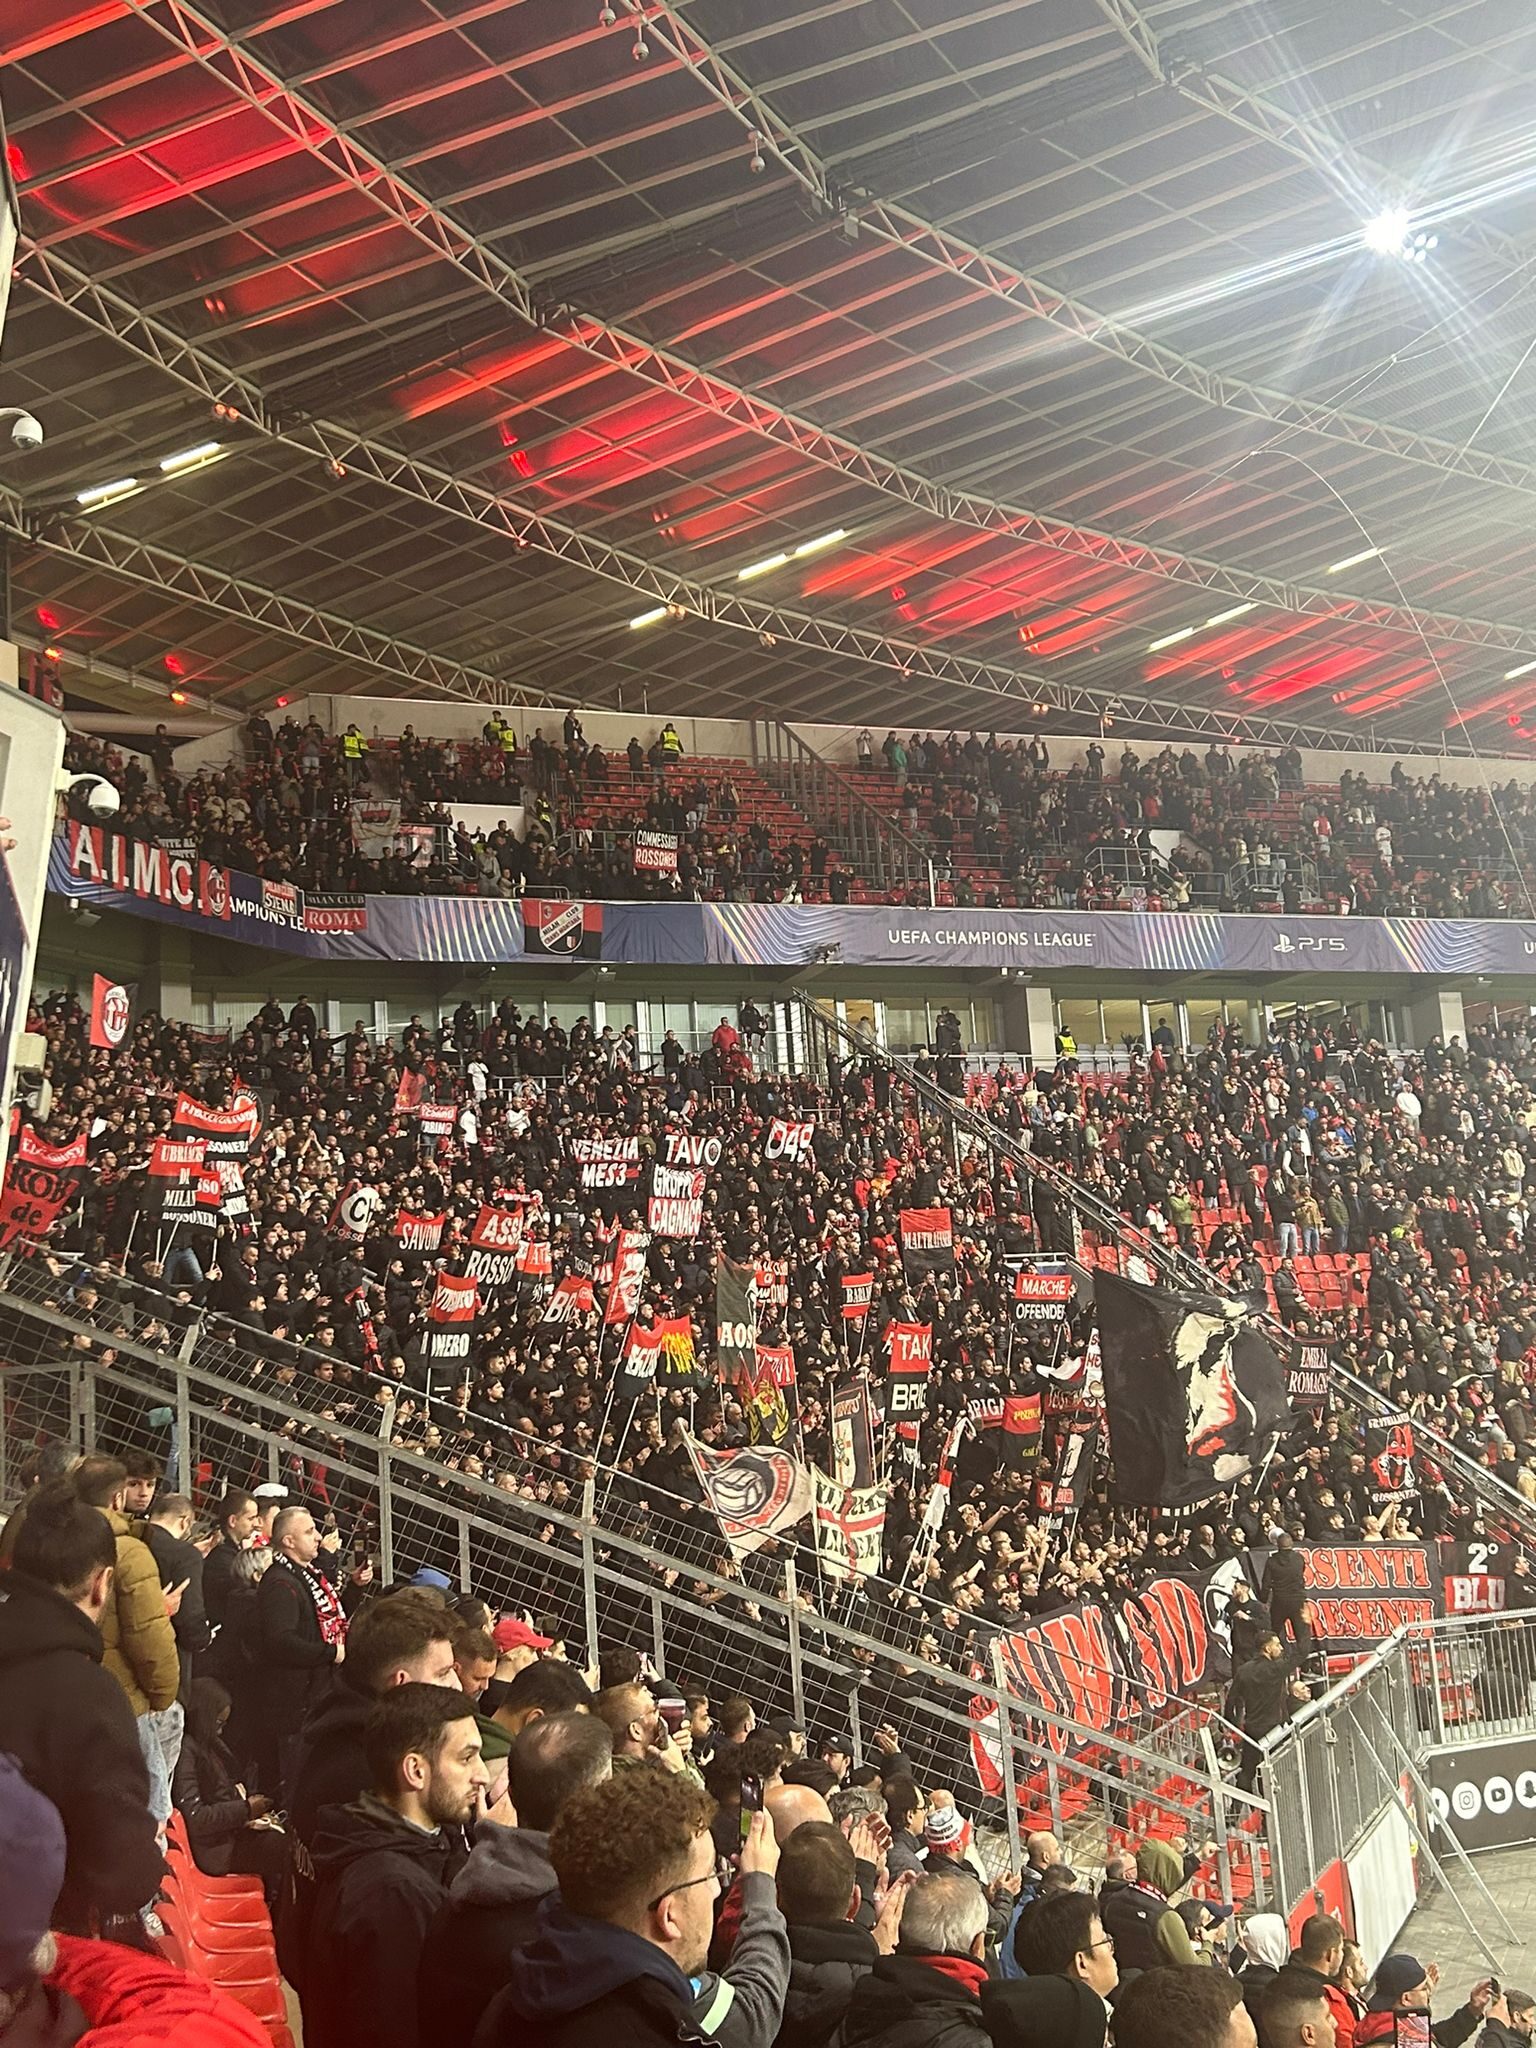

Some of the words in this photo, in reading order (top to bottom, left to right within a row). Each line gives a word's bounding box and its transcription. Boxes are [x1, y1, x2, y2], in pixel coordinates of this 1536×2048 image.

[265, 893, 295, 913] SIENA
[337, 895, 365, 904] CLUB
[229, 895, 287, 926] AMPIONS
[310, 912, 361, 926] ROMA
[888, 930, 930, 944] UEFA
[935, 930, 1028, 946] CHAMPIONS
[1034, 932, 1094, 946] LEAGUE
[1298, 938, 1345, 950] PS5
[572, 1136, 639, 1160] VENEZIA
[1021, 1279, 1066, 1295] MARCHE
[1468, 1543, 1499, 1574] 2°
[1453, 1577, 1505, 1610] BLU
